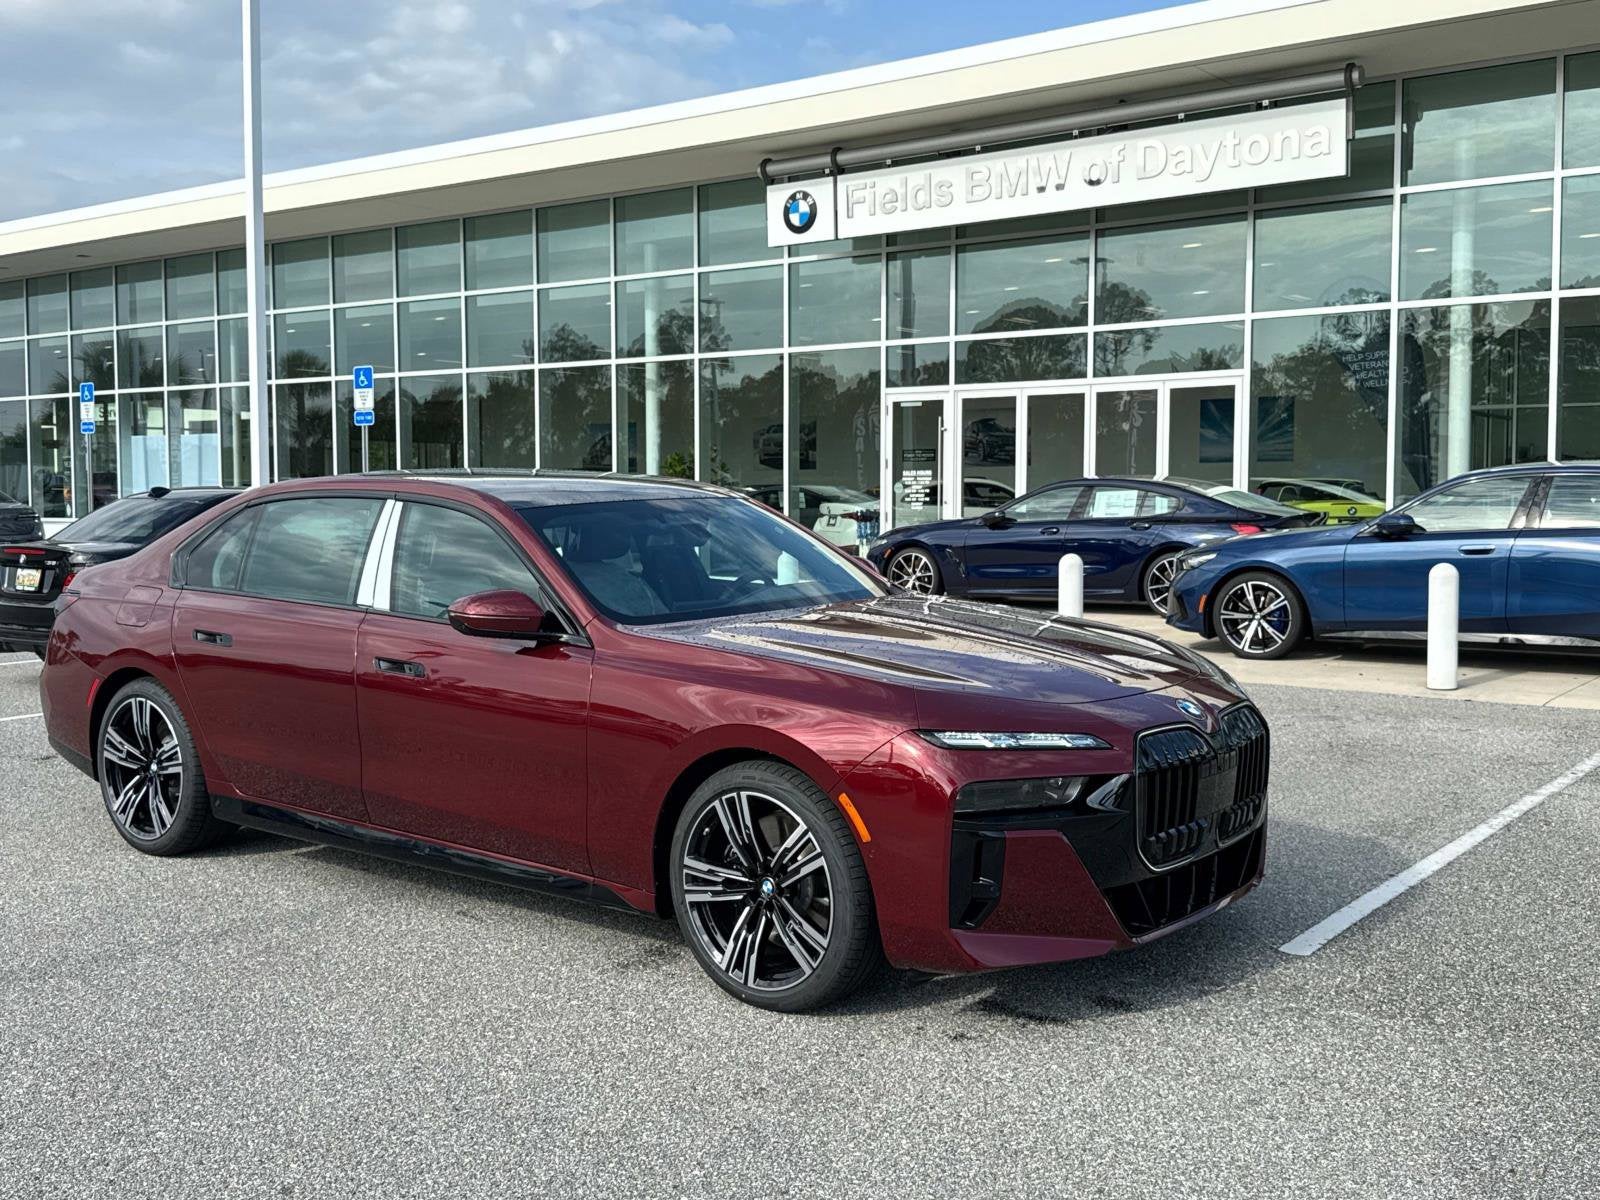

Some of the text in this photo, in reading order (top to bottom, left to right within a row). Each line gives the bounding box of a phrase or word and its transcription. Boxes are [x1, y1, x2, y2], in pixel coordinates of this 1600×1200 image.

[845, 124, 1331, 219] Fields BMW of Daytona
[785, 191, 815, 207] BMW
[1342, 351, 1390, 362] HELP SUPP
